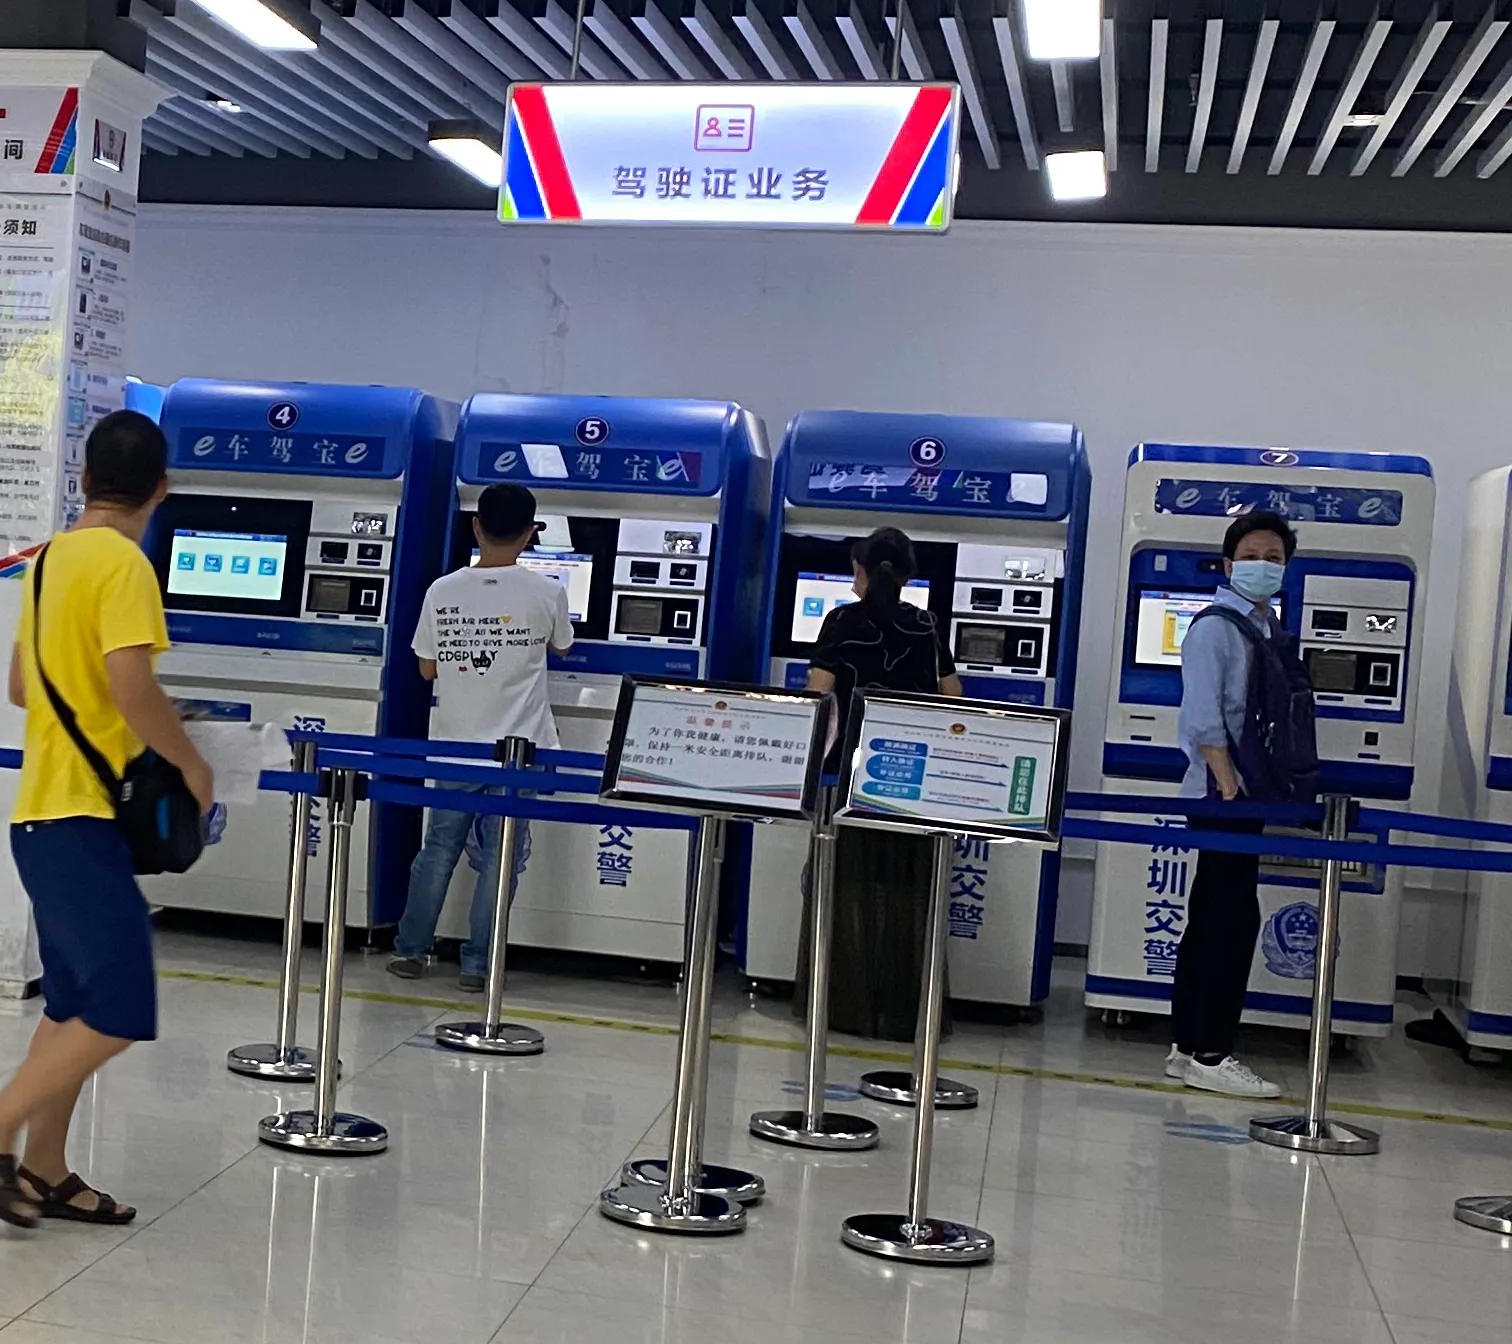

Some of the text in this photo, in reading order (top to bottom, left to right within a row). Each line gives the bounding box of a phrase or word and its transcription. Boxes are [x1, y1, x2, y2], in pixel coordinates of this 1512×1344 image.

[612, 166, 830, 201] 驾驶证业务
[275, 406, 291, 424] 4
[585, 420, 601, 440] 5
[919, 441, 936, 460] 6
[1271, 453, 1288, 463] 7
